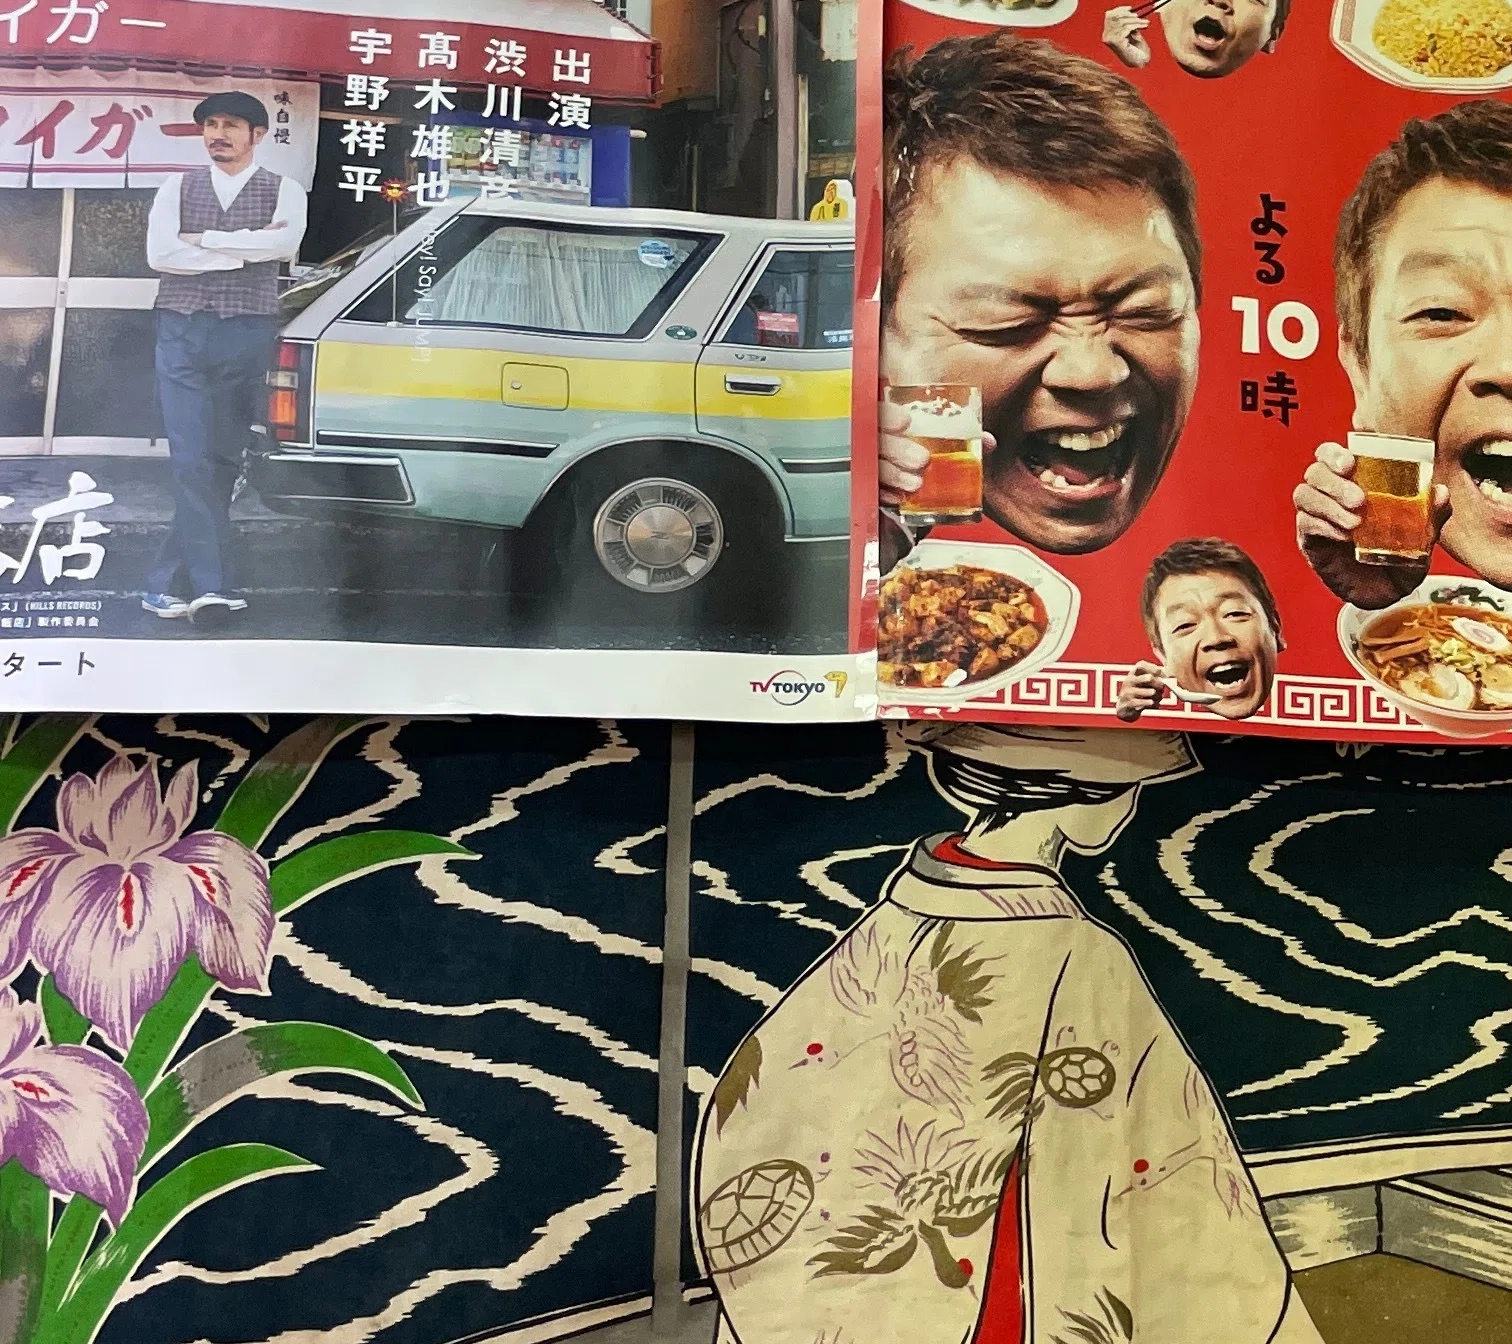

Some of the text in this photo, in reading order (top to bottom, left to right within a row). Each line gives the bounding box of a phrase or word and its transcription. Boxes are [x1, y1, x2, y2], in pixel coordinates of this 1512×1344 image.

[0, 98, 204, 160] イガー
[338, 28, 393, 203] 宇野祥平
[547, 49, 592, 130] 出演
